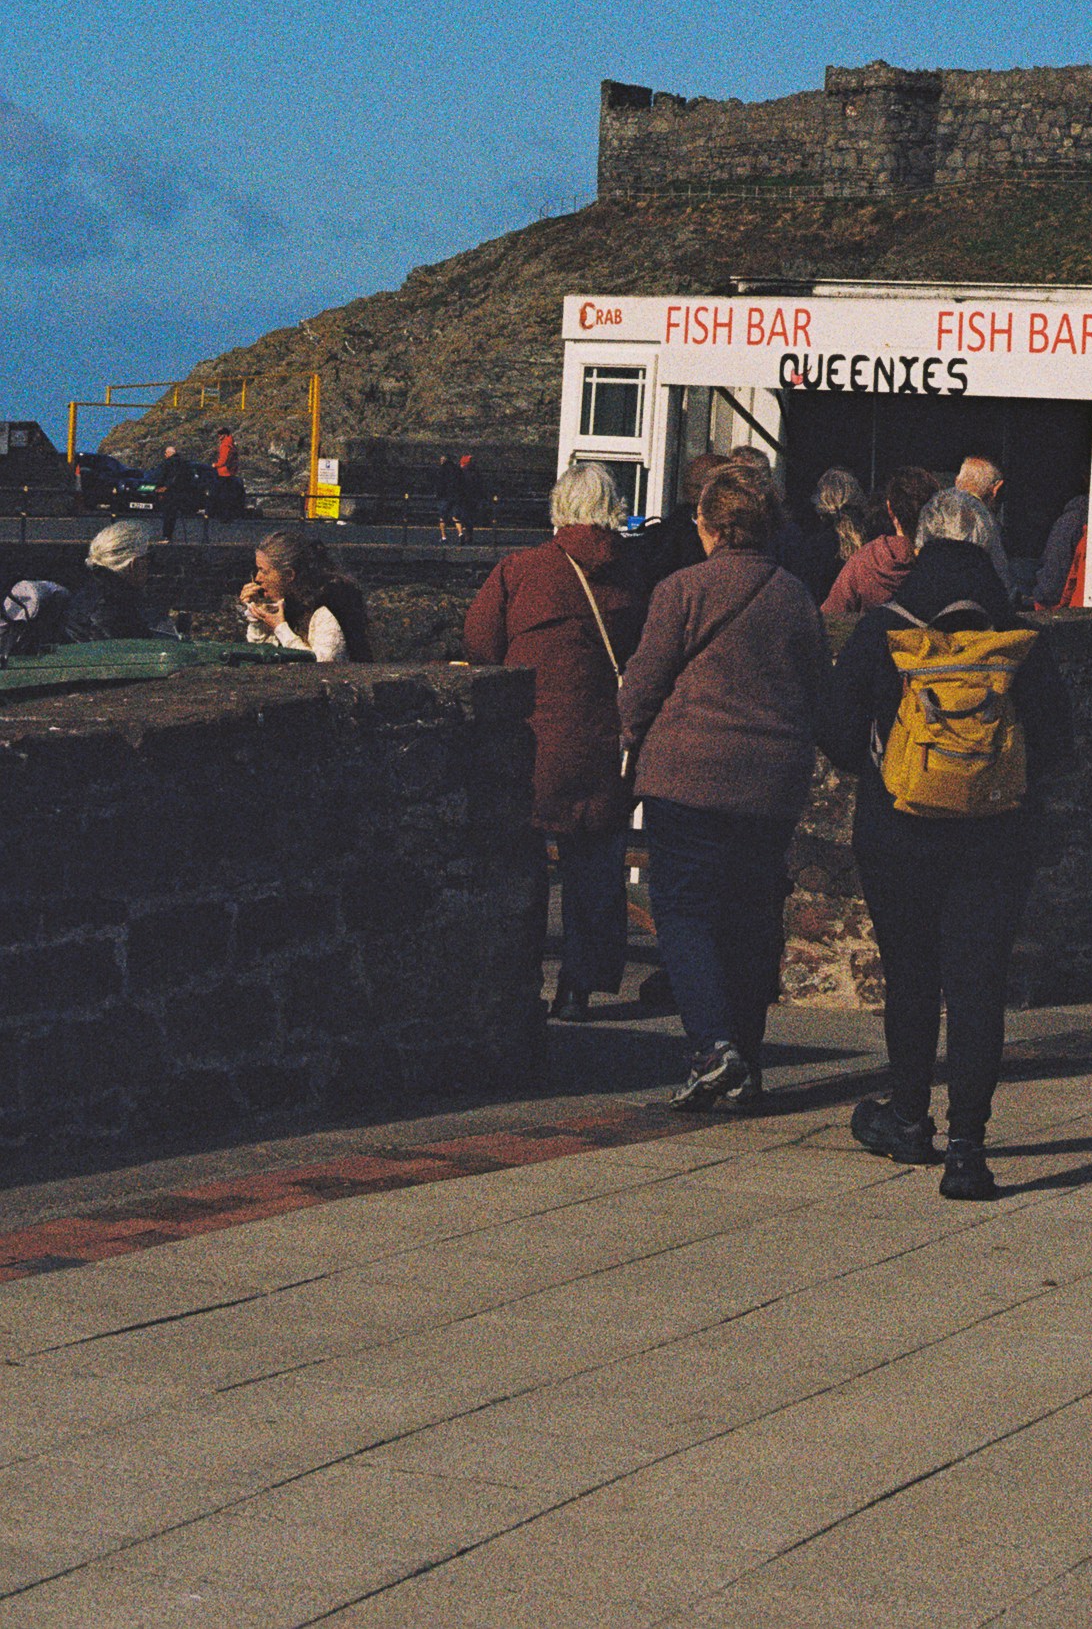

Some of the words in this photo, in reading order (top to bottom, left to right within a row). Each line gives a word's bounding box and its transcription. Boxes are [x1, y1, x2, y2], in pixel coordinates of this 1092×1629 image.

[579, 302, 622, 330] CRAB
[665, 306, 733, 345] FISH
[746, 307, 811, 347] BAR
[936, 311, 1012, 352] FISH
[779, 353, 968, 396] QUEENIES
